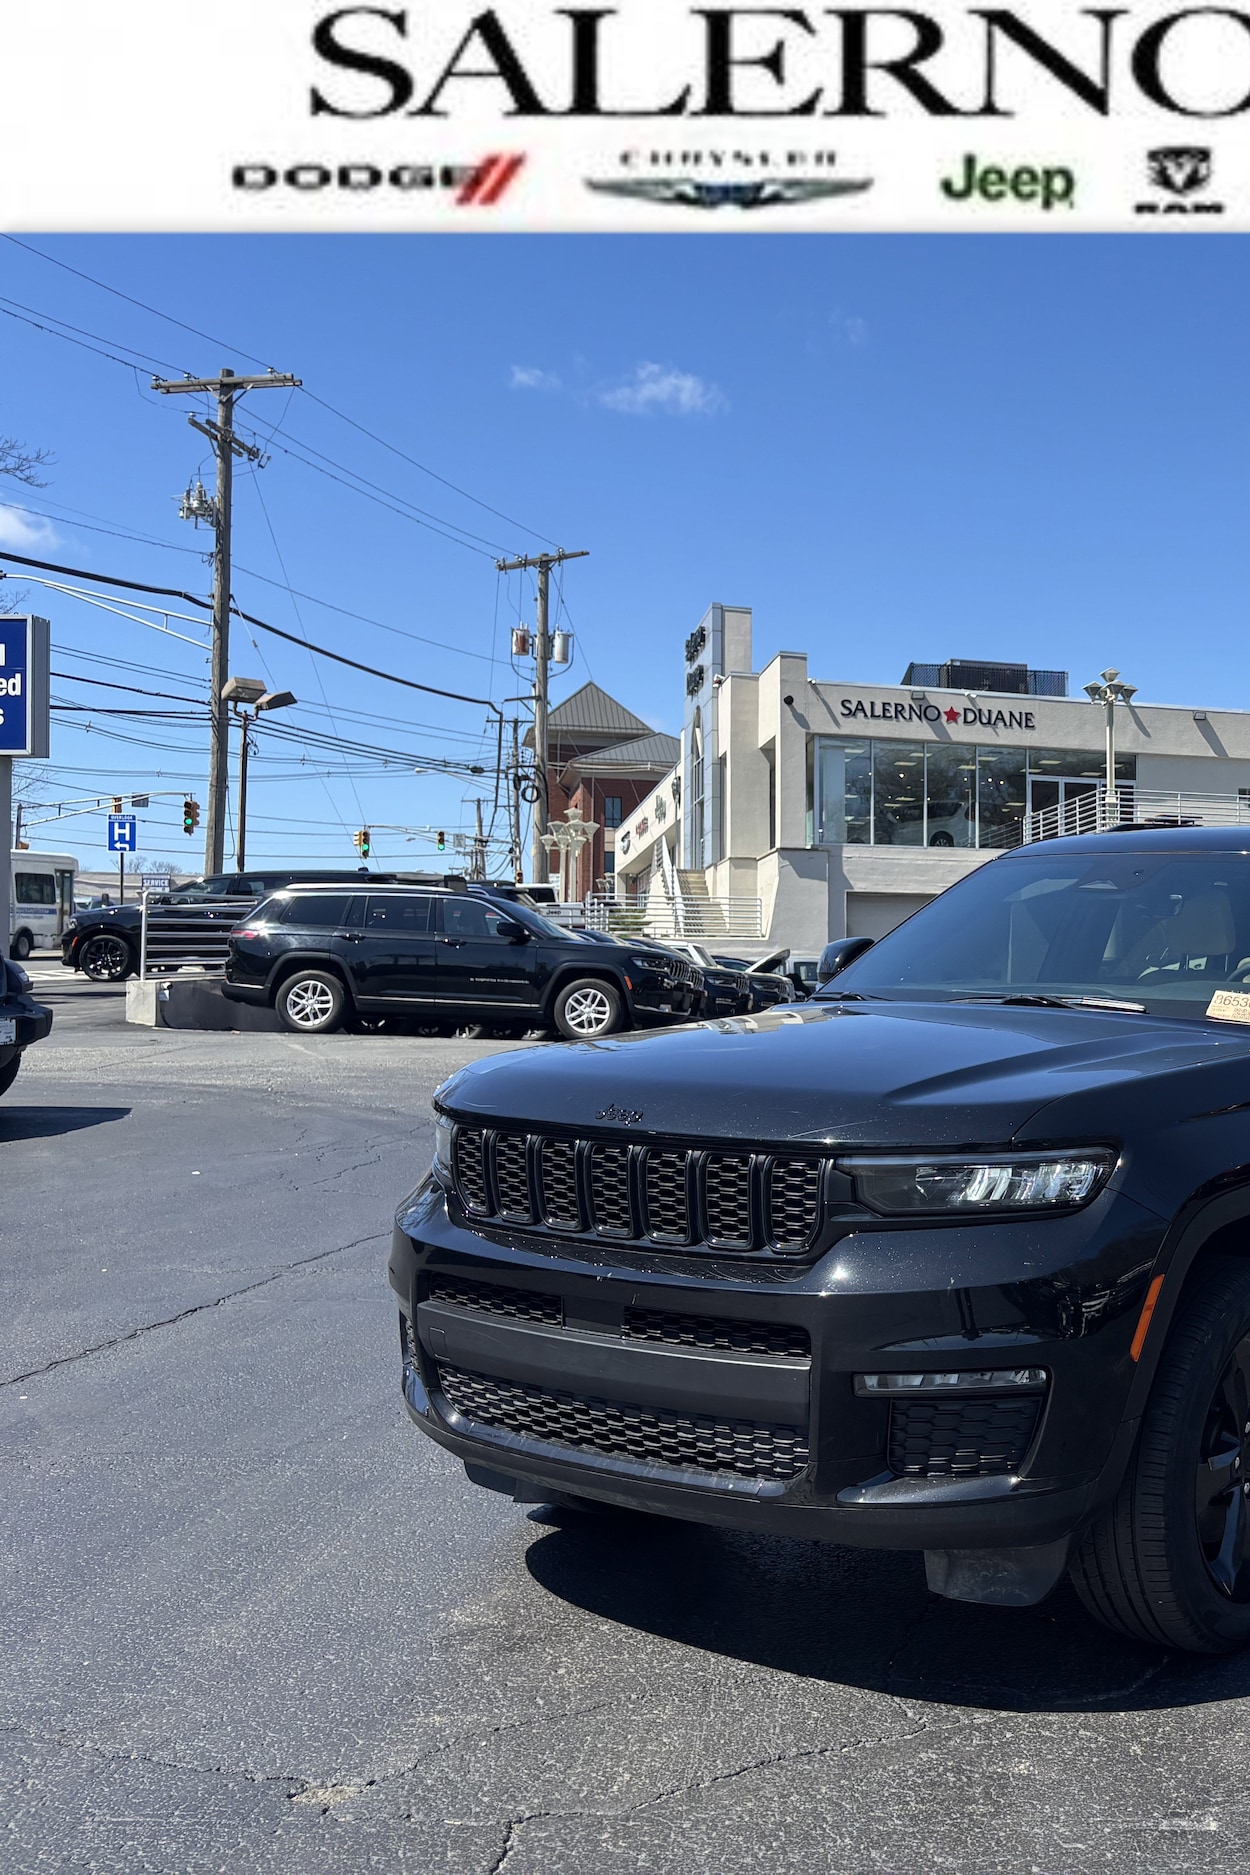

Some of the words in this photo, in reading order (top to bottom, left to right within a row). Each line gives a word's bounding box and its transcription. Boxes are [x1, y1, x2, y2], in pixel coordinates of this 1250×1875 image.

[840, 699, 941, 723] SALERNO
[962, 707, 1036, 729] DUANE
[113, 822, 130, 841] H
[143, 879, 168, 887] SERVICE
